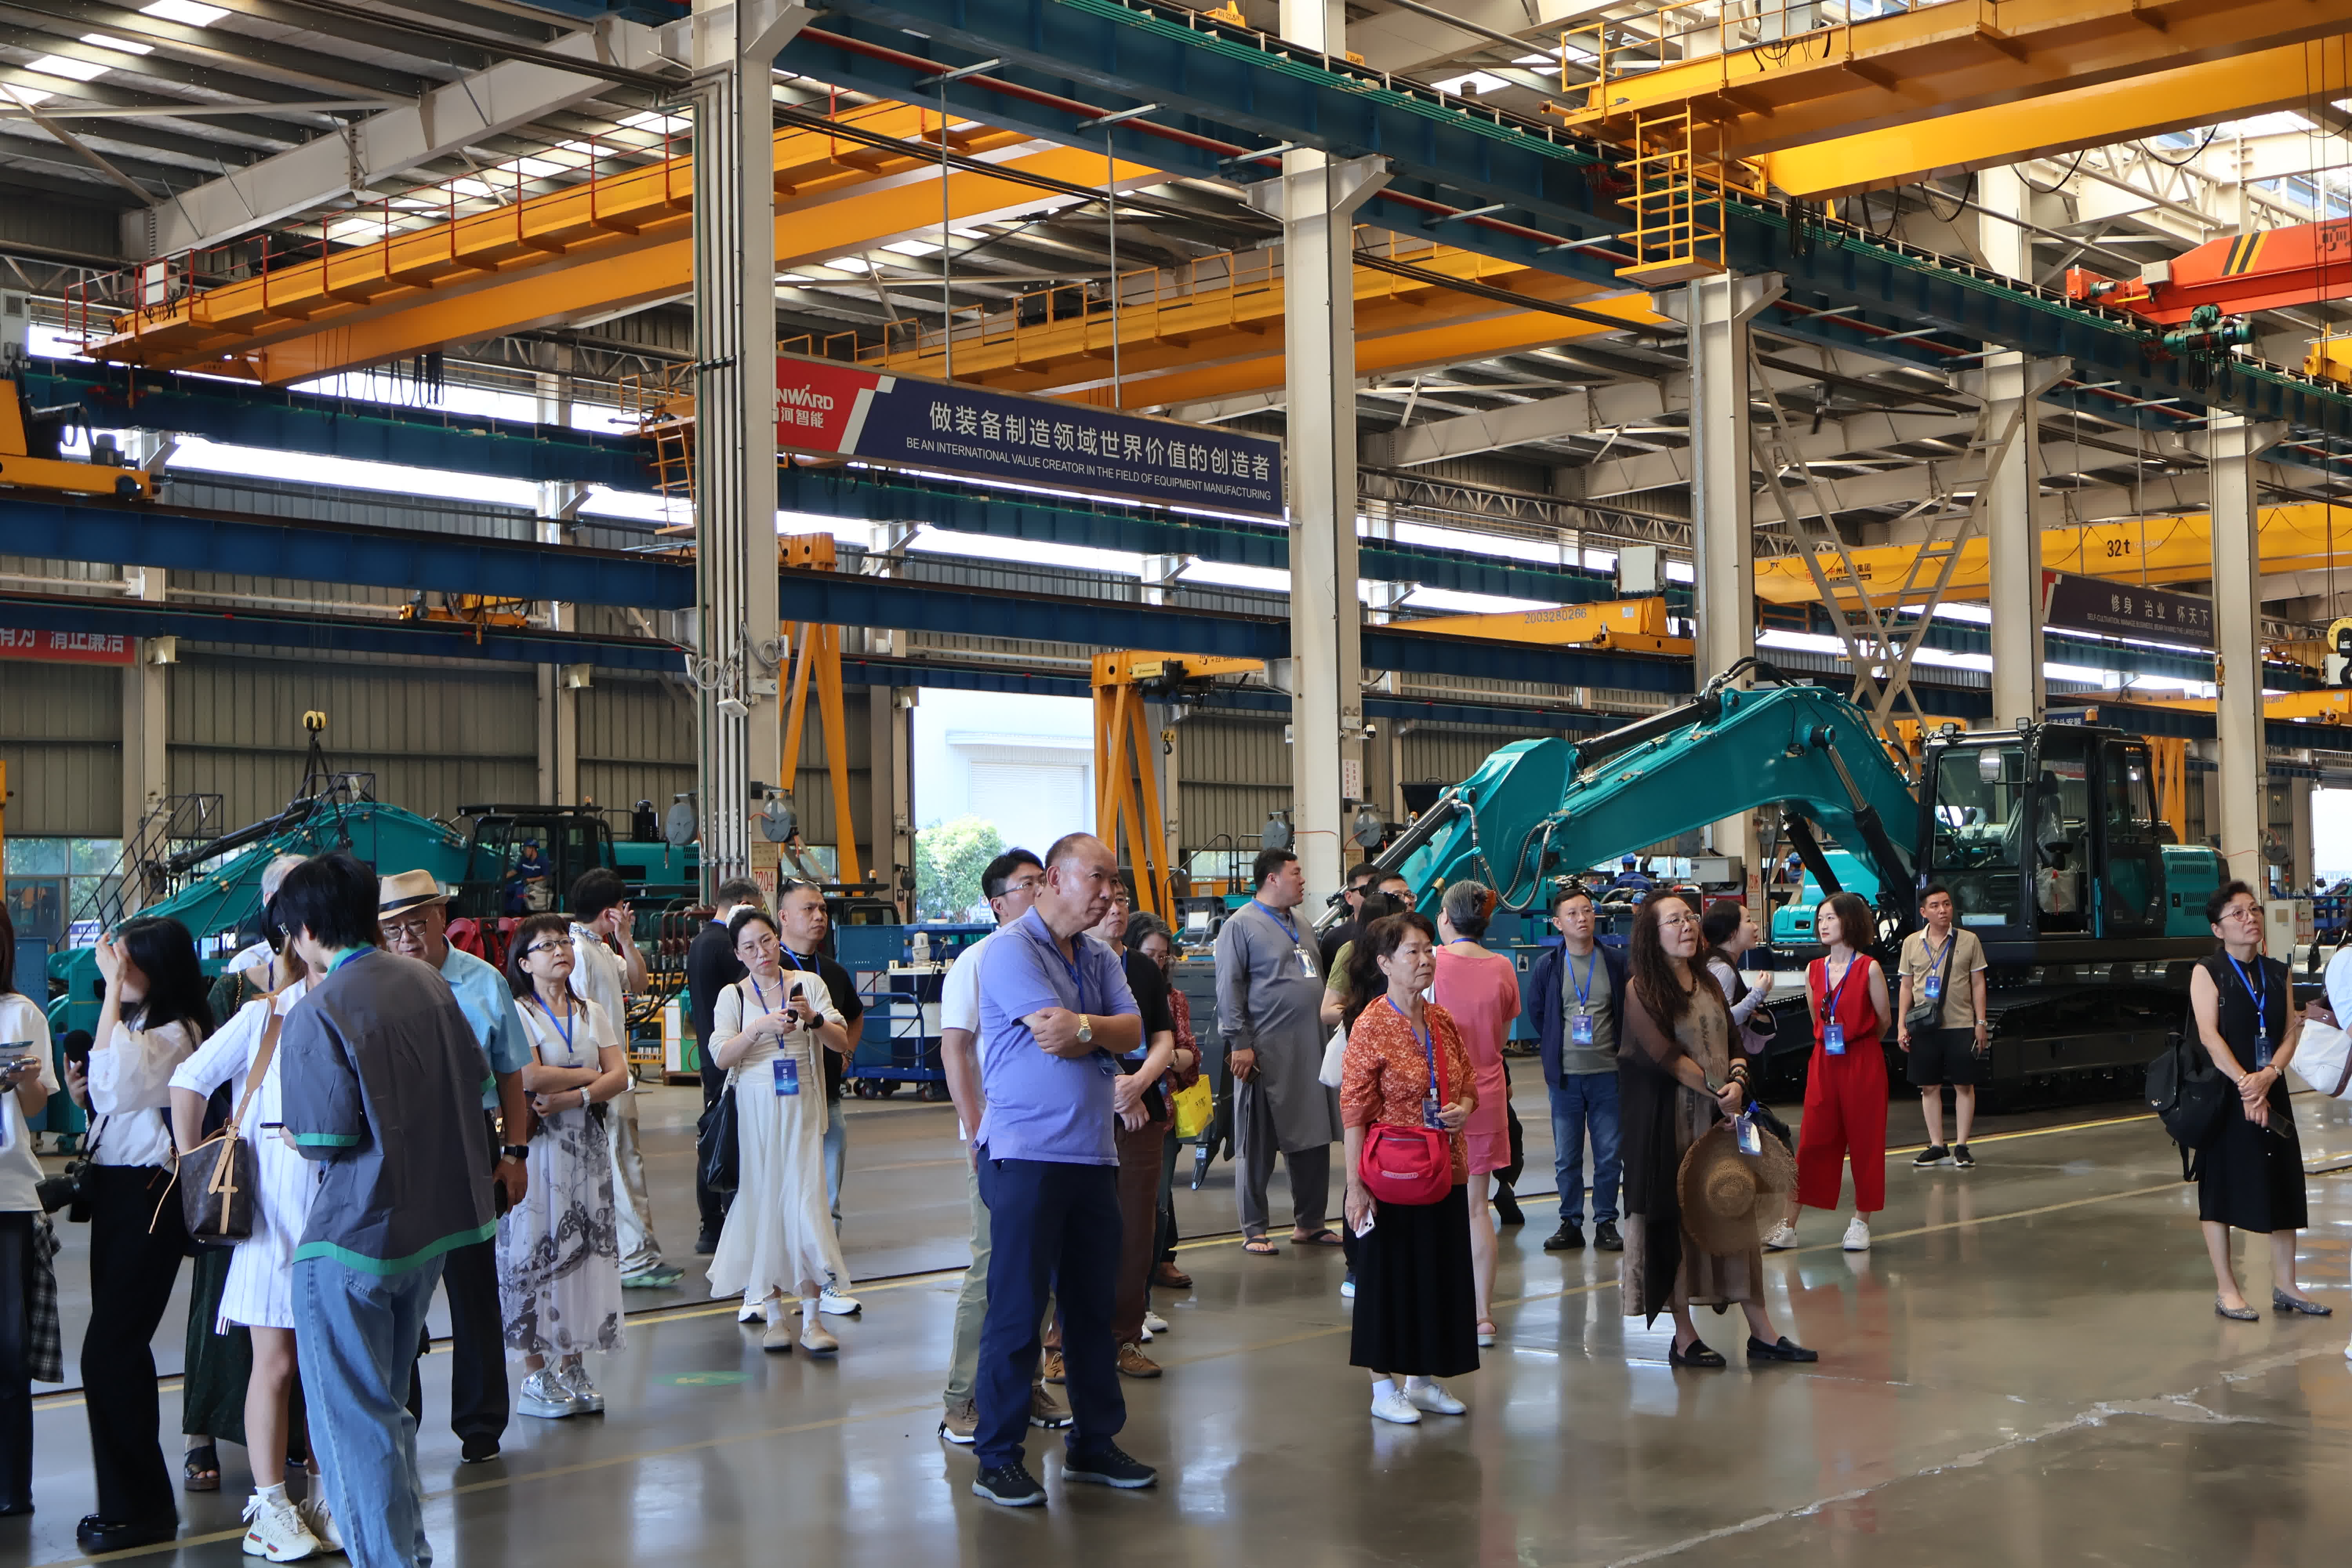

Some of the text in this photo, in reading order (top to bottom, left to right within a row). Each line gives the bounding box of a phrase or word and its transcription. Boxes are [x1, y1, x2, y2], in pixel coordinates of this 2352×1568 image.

[777, 384, 834, 410] NWARD
[777, 407, 824, 428] 河智能
[930, 401, 1270, 482] 做装备制造领域世界价值的创造者
[907, 437, 1271, 501] BE AN INTERNATIONAL VALUE CREATOR IN THE FIELD OF EQUIPMENT MANUFACTURING
[1524, 608, 1587, 624] 2003280266
[2111, 593, 2209, 626] 修身 治业 怀天下
